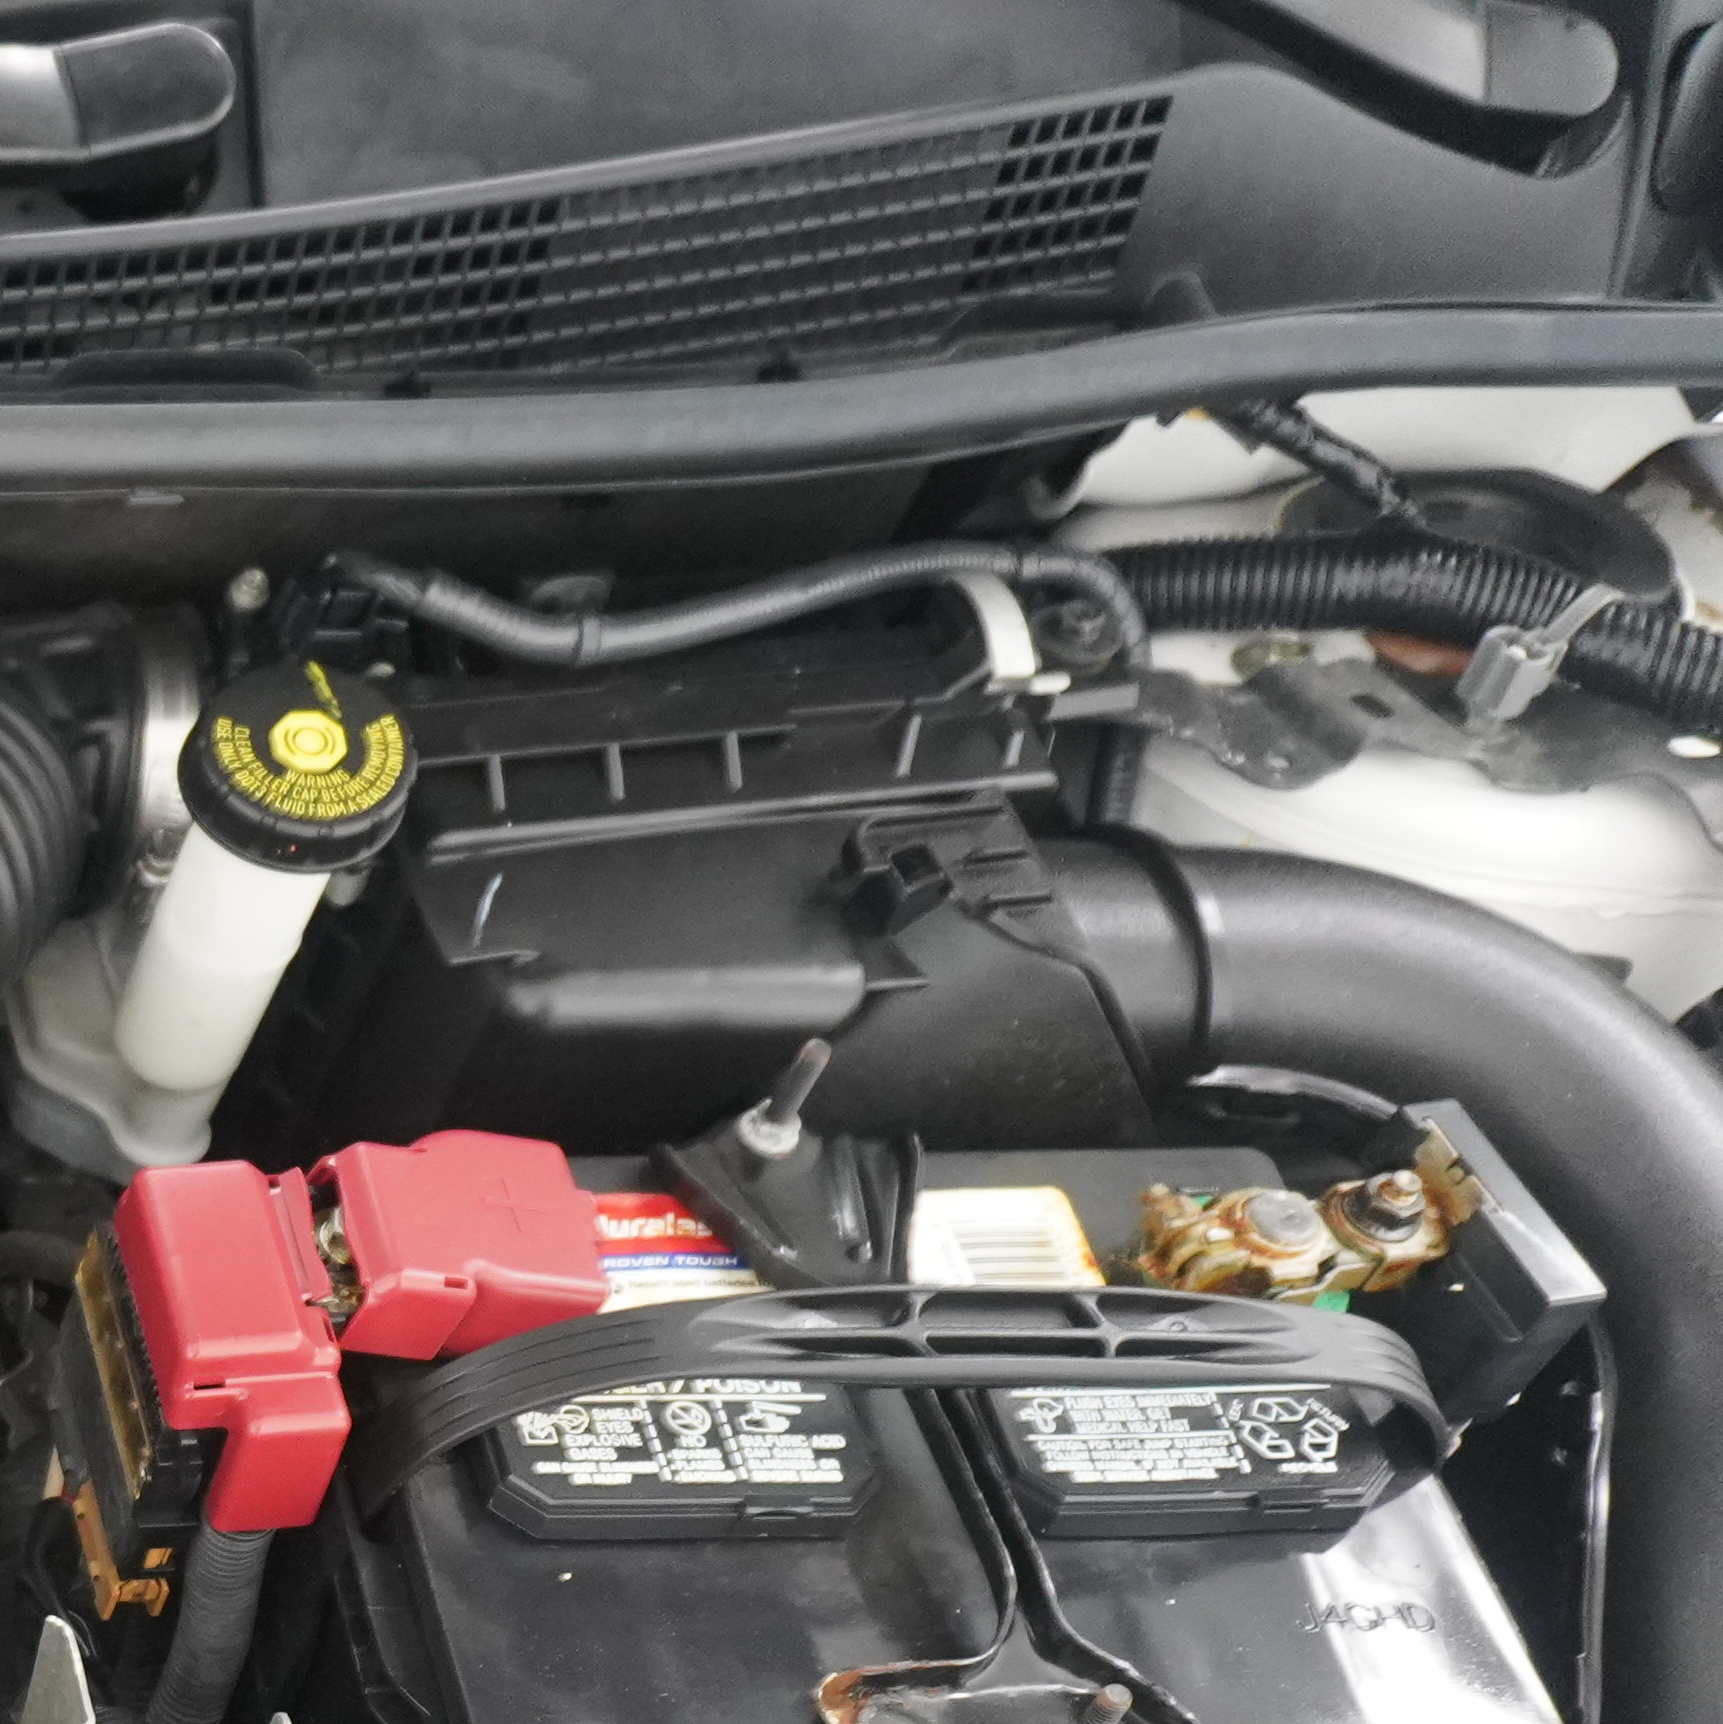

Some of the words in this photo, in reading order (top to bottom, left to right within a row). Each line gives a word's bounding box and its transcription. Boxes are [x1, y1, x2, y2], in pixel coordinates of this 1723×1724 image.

[217, 717, 232, 742] USE
[219, 742, 243, 769] ONLY
[381, 715, 404, 780] CONTAINER
[235, 726, 256, 764] CLEAN
[252, 762, 288, 794] FILLER
[292, 784, 318, 801] CAP
[322, 778, 369, 801] BEFORE
[366, 723, 387, 781] REMOVING
[286, 768, 350, 788] WARNING
[356, 775, 395, 810] SEALED
[268, 791, 306, 815] FLUID
[309, 801, 347, 817] FROM
[349, 801, 360, 814] A
[604, 1256, 669, 1268] ROVEN
[675, 1255, 738, 1266] TOUGH
[592, 1408, 643, 1423] SHIELD
[596, 1421, 635, 1434] EYES
[565, 1434, 644, 1448] EXPLOSIVE
[678, 1435, 707, 1448] NO
